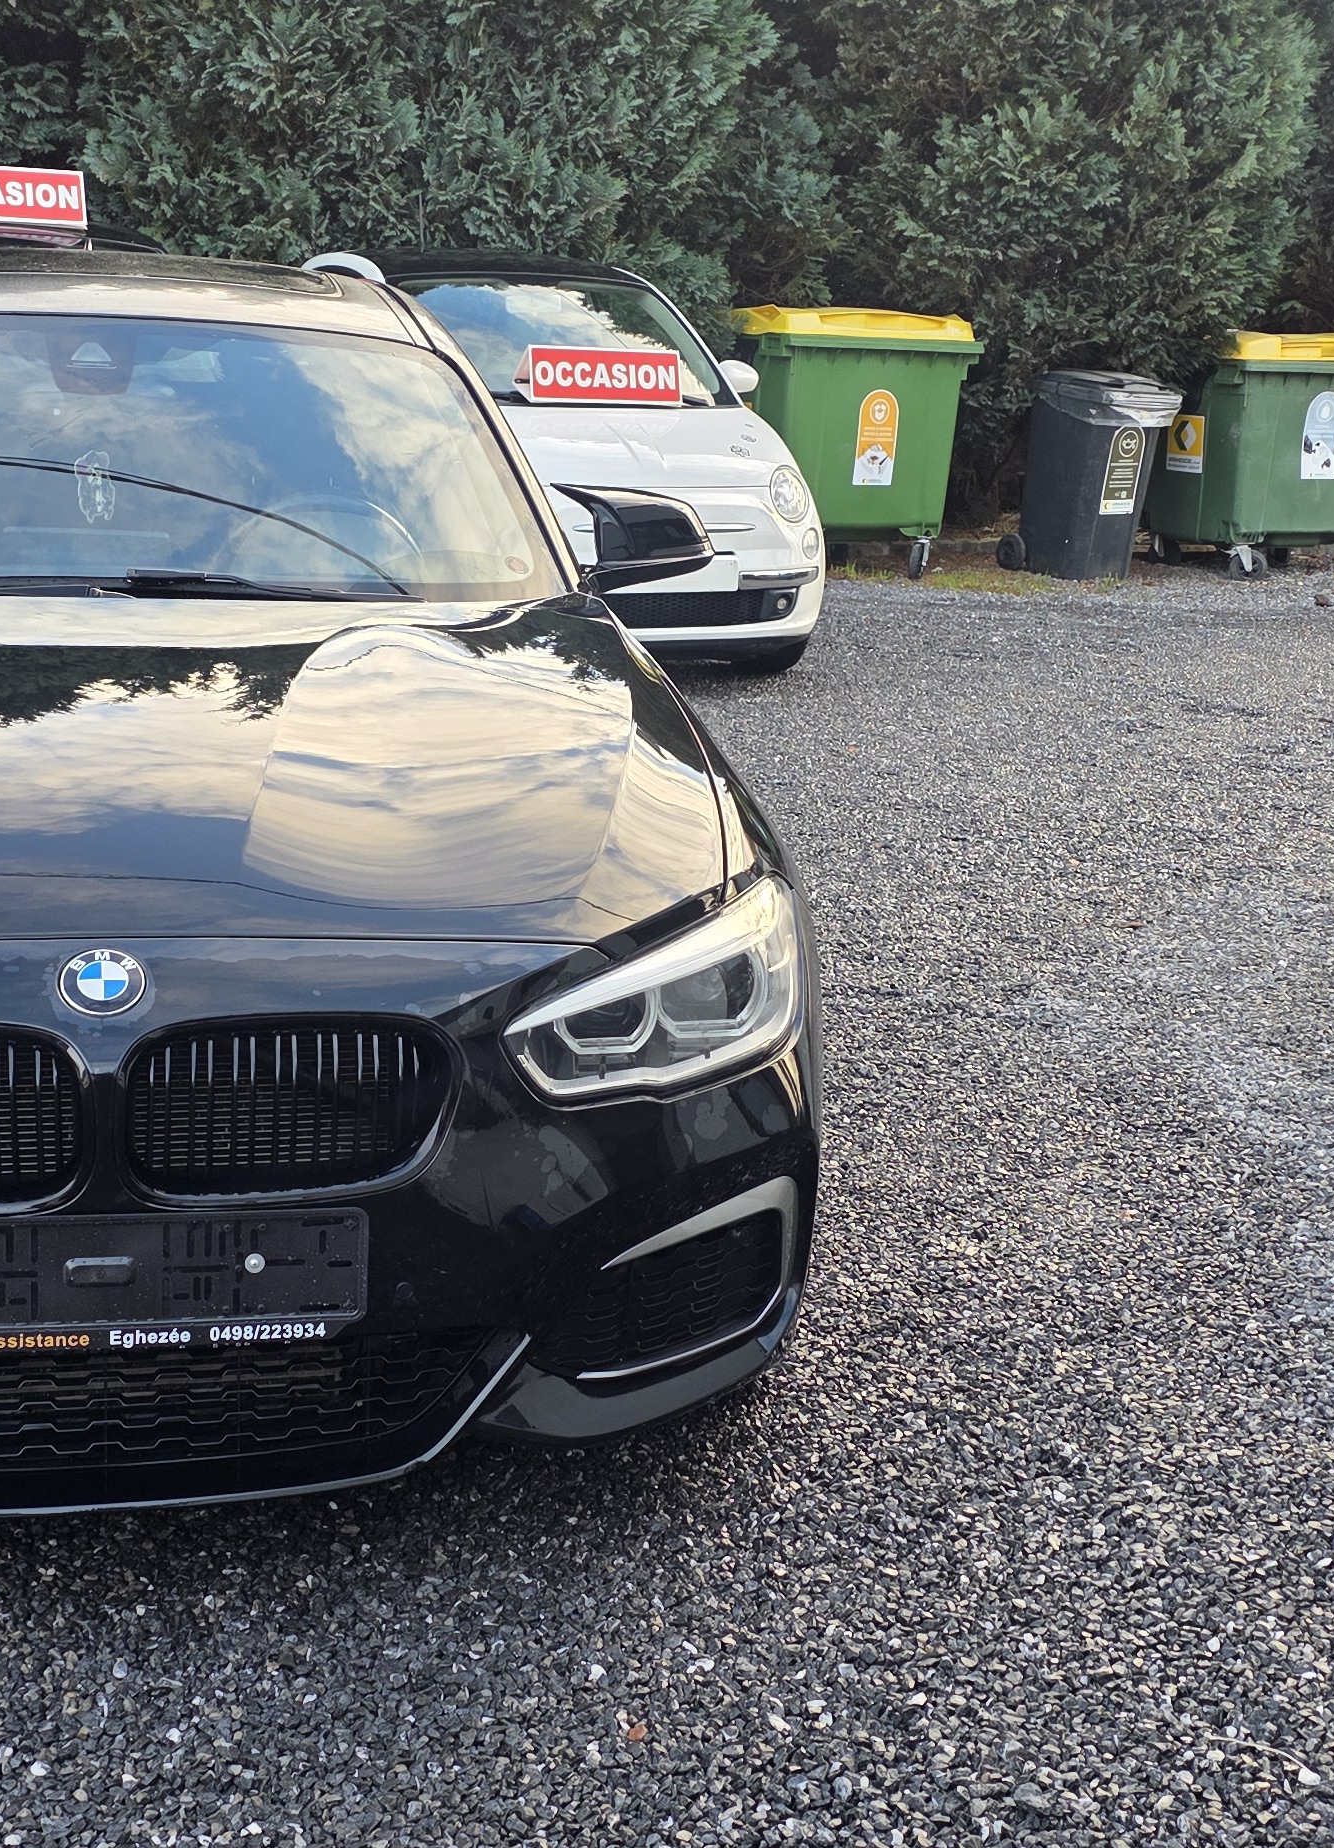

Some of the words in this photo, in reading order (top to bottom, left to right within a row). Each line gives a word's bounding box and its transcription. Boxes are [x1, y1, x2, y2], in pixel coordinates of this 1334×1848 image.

[535, 360, 677, 390] OCCASION
[69, 951, 137, 971] BMW
[109, 1327, 191, 1348] Eghezée
[210, 1322, 326, 1342] 0498/223934
